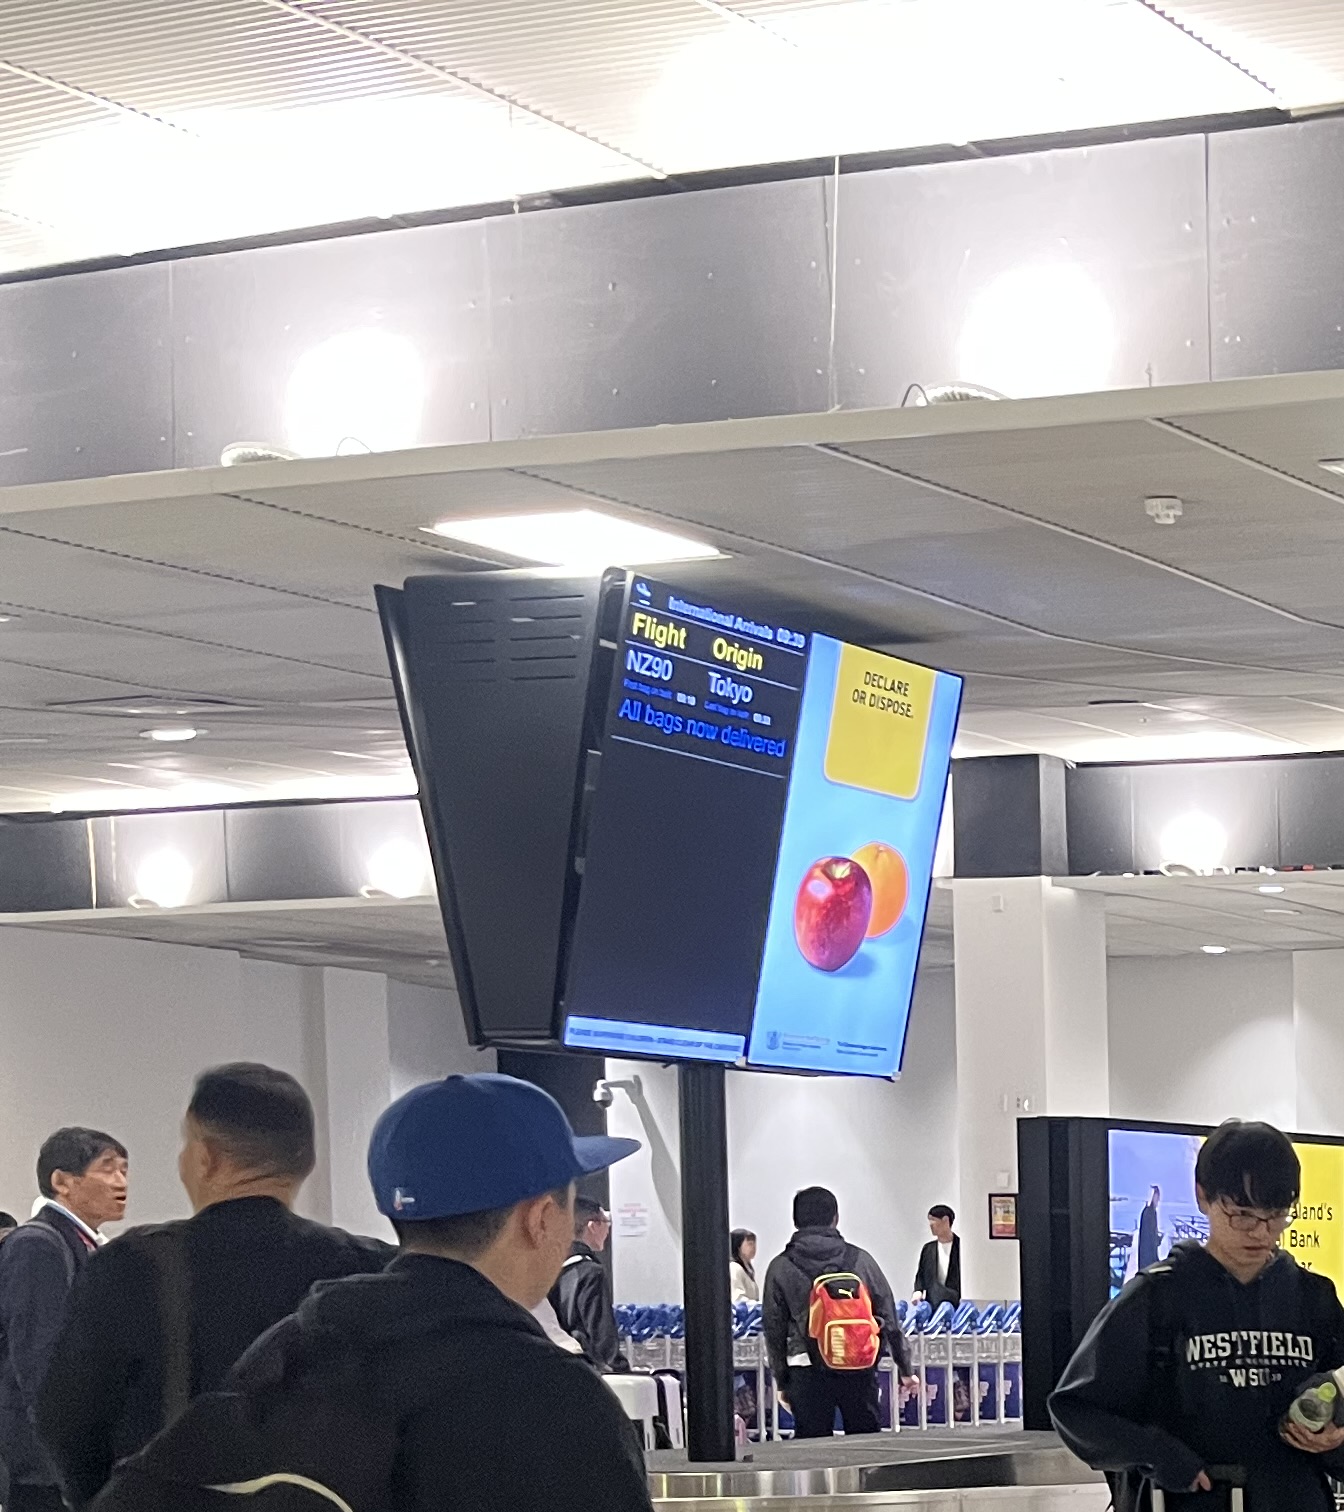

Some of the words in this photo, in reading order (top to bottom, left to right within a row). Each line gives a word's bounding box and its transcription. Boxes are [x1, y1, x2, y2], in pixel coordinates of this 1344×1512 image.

[632, 613, 686, 649] Flight
[713, 638, 762, 670] Origin
[626, 649, 672, 680] NZ90
[708, 671, 752, 704] Tokyo
[864, 672, 909, 697] DECLARE
[852, 689, 866, 705] OR
[869, 693, 913, 718] DISPOSE.
[619, 699, 641, 721] All
[644, 704, 682, 734] bags
[686, 719, 718, 739] now
[721, 726, 786, 757] delivered
[1290, 1230, 1320, 1248] Bank
[1186, 1330, 1313, 1363] WESTFIELD
